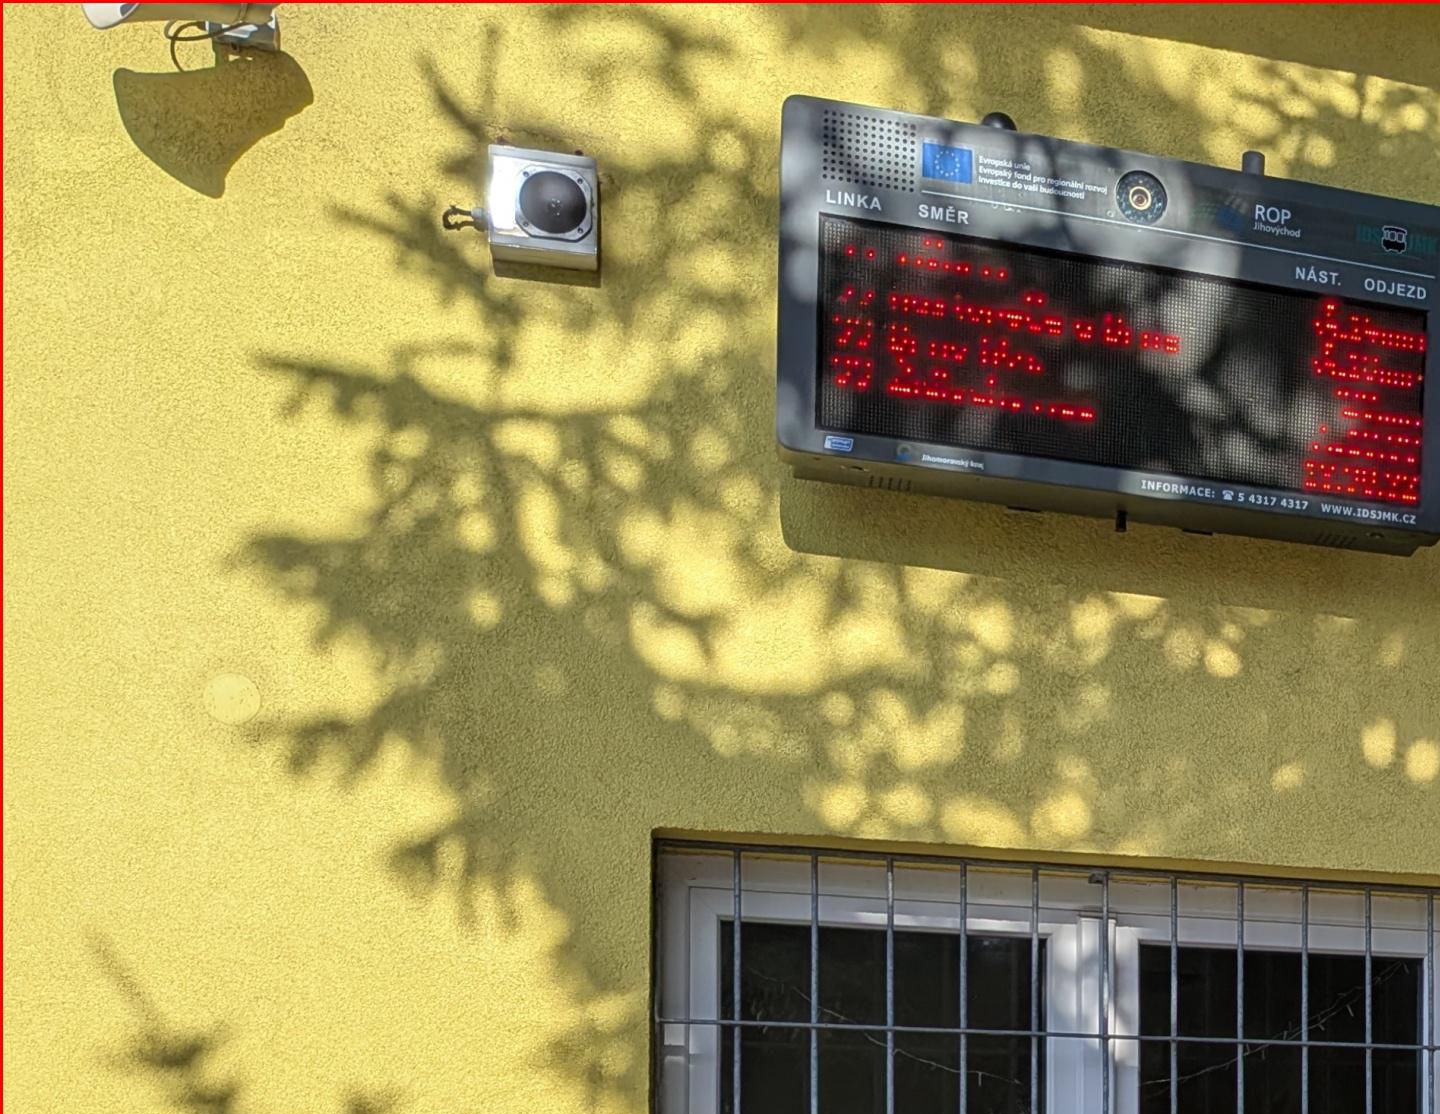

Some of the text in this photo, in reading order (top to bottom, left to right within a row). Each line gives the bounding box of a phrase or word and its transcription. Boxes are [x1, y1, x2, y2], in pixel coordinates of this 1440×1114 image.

[978, 155, 1013, 168] Evropská
[979, 165, 1013, 179] Evropský
[1014, 170, 1032, 181] fond
[1033, 175, 1046, 185] pro
[1085, 184, 1107, 196] rozvoj
[979, 176, 1011, 188] Investice
[1012, 181, 1023, 189] do
[826, 189, 882, 211] LINKA
[918, 204, 969, 225] SMĚR
[1255, 204, 1292, 225] ROP
[1253, 221, 1301, 238] Jihovýchod
[1296, 266, 1341, 286] NÁST.
[1364, 277, 1427, 300] ODJEZD
[1141, 479, 1309, 511] INFORMACE: 5 4317 4317
[1321, 502, 1417, 525] WWW.IDSJMK.CZ
